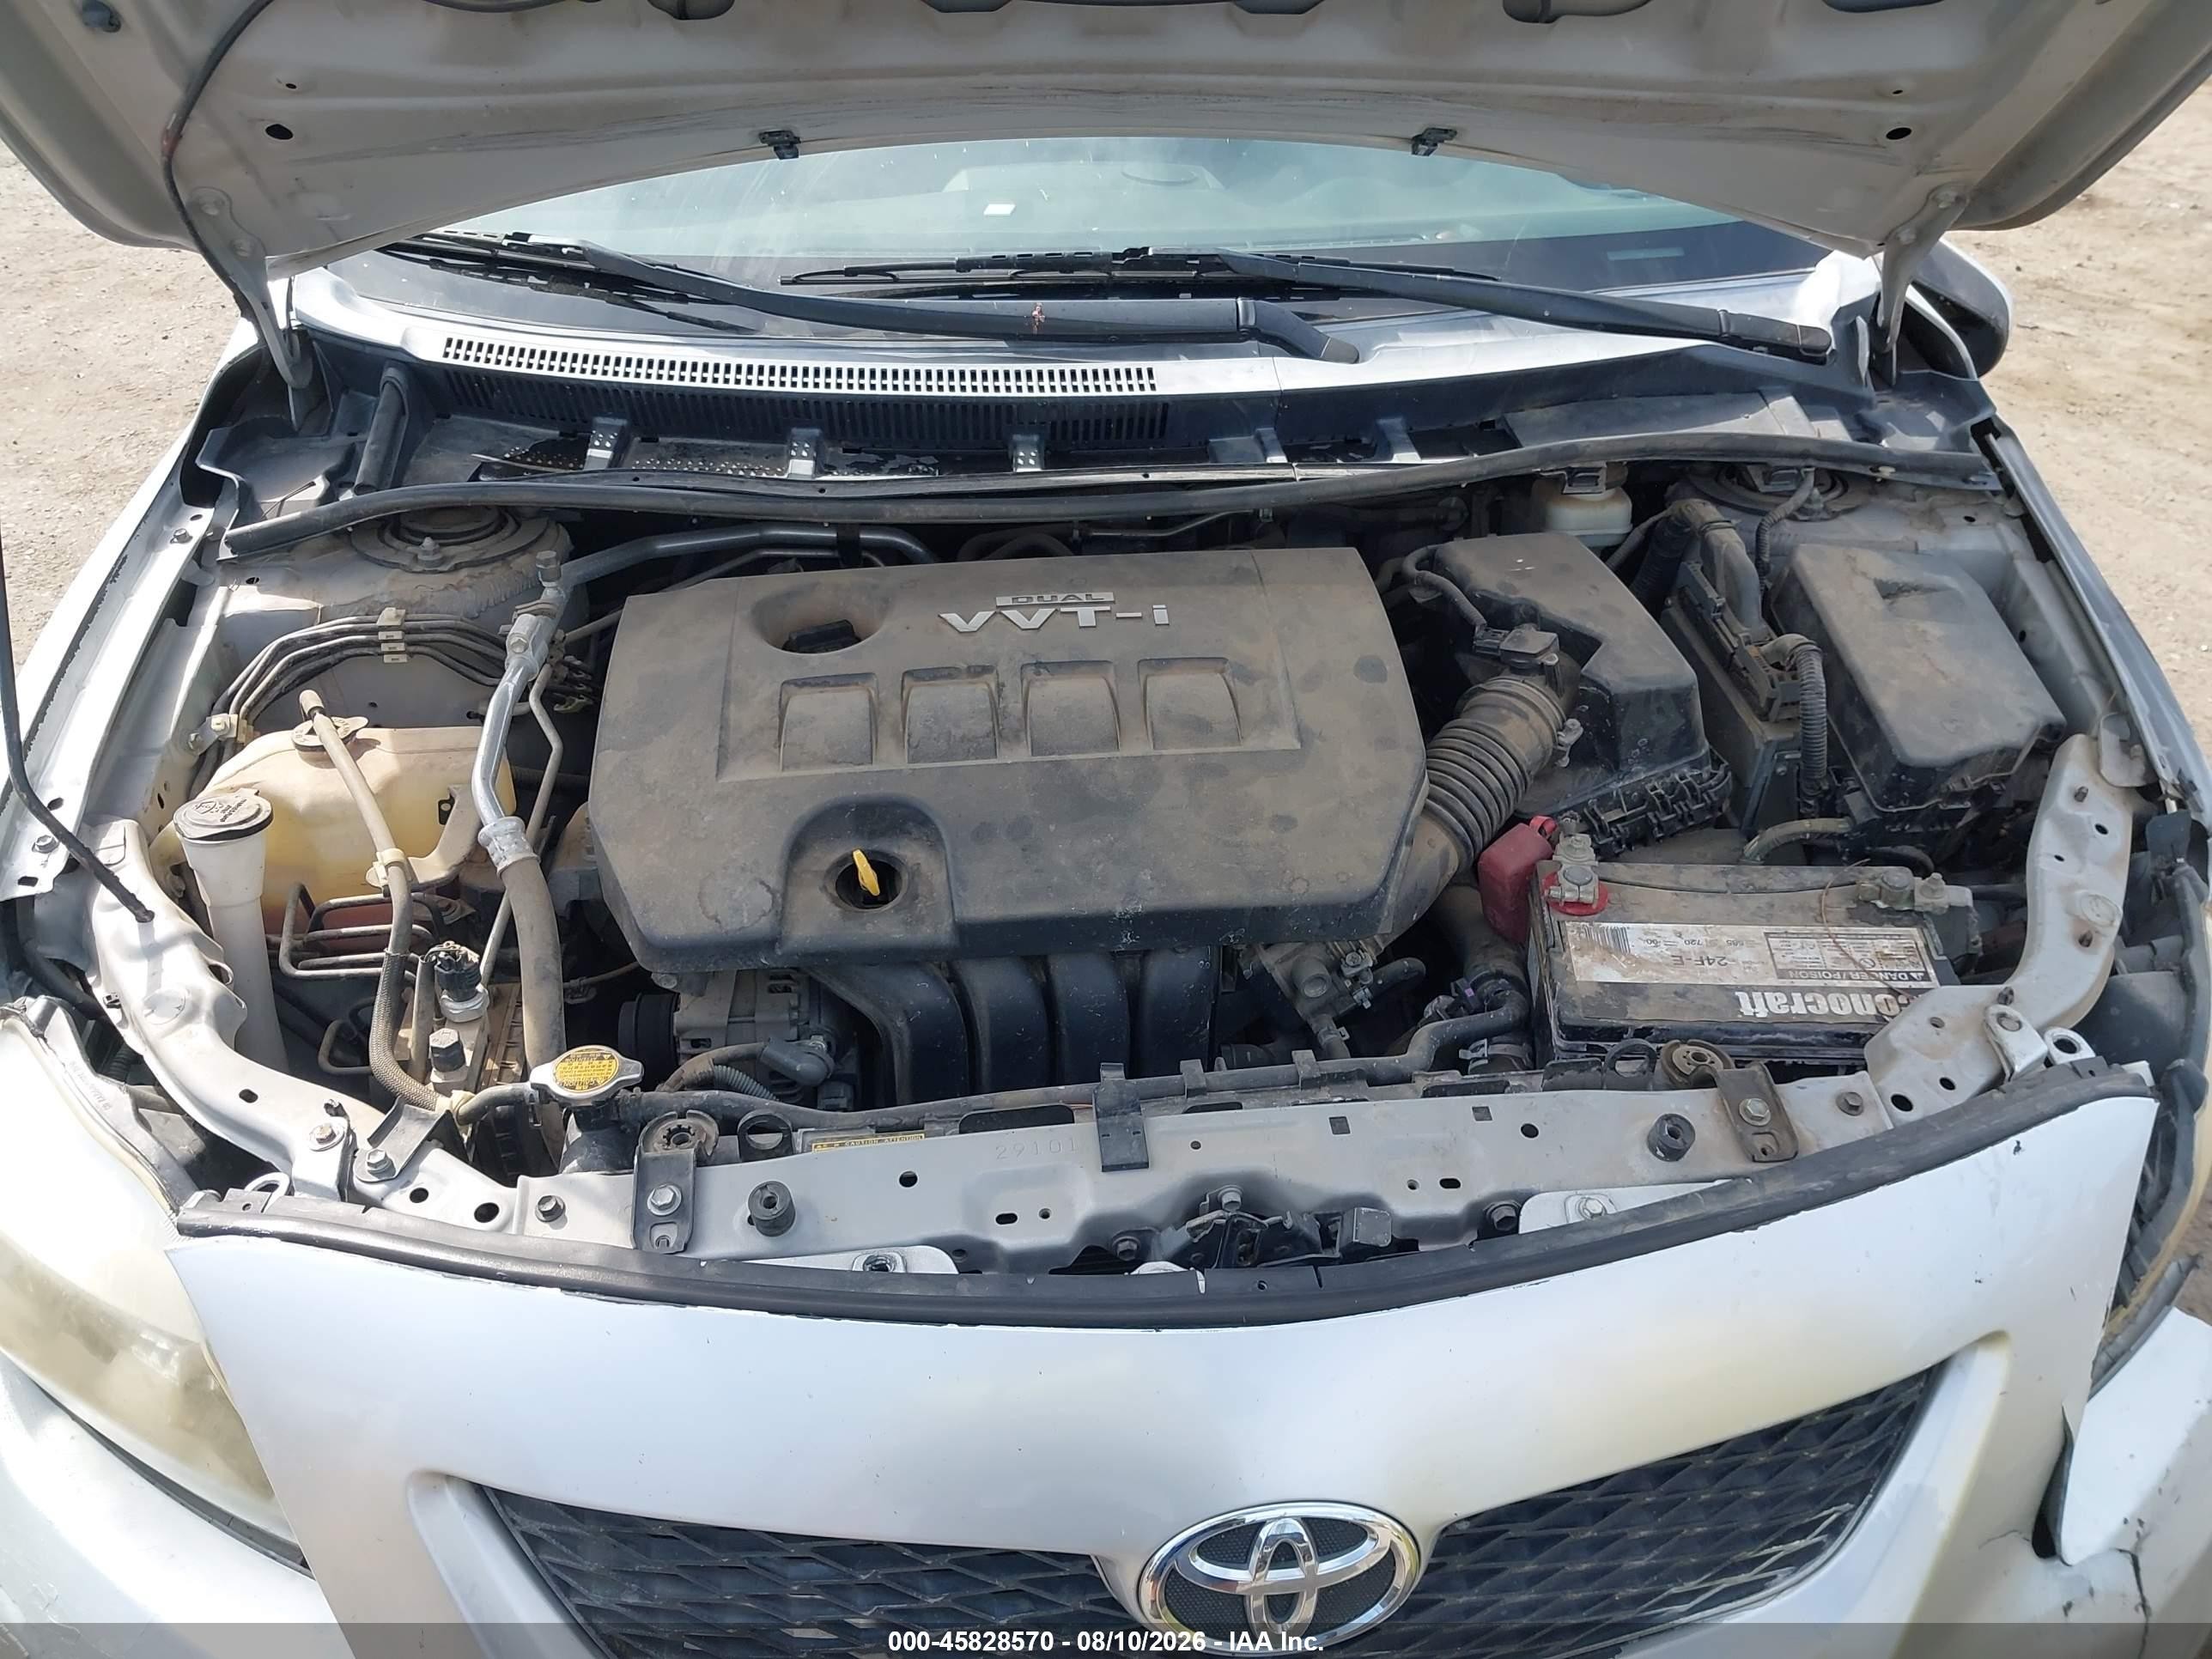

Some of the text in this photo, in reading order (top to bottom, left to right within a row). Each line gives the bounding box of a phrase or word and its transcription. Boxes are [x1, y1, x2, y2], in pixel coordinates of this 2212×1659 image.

[1011, 592, 1106, 604] DUAL
[939, 605, 1170, 633] VVT-i
[1670, 955, 1728, 967] 24F-E
[884, 1134, 923, 1144] ATTENTION
[995, 1138, 1079, 1161] 29101
